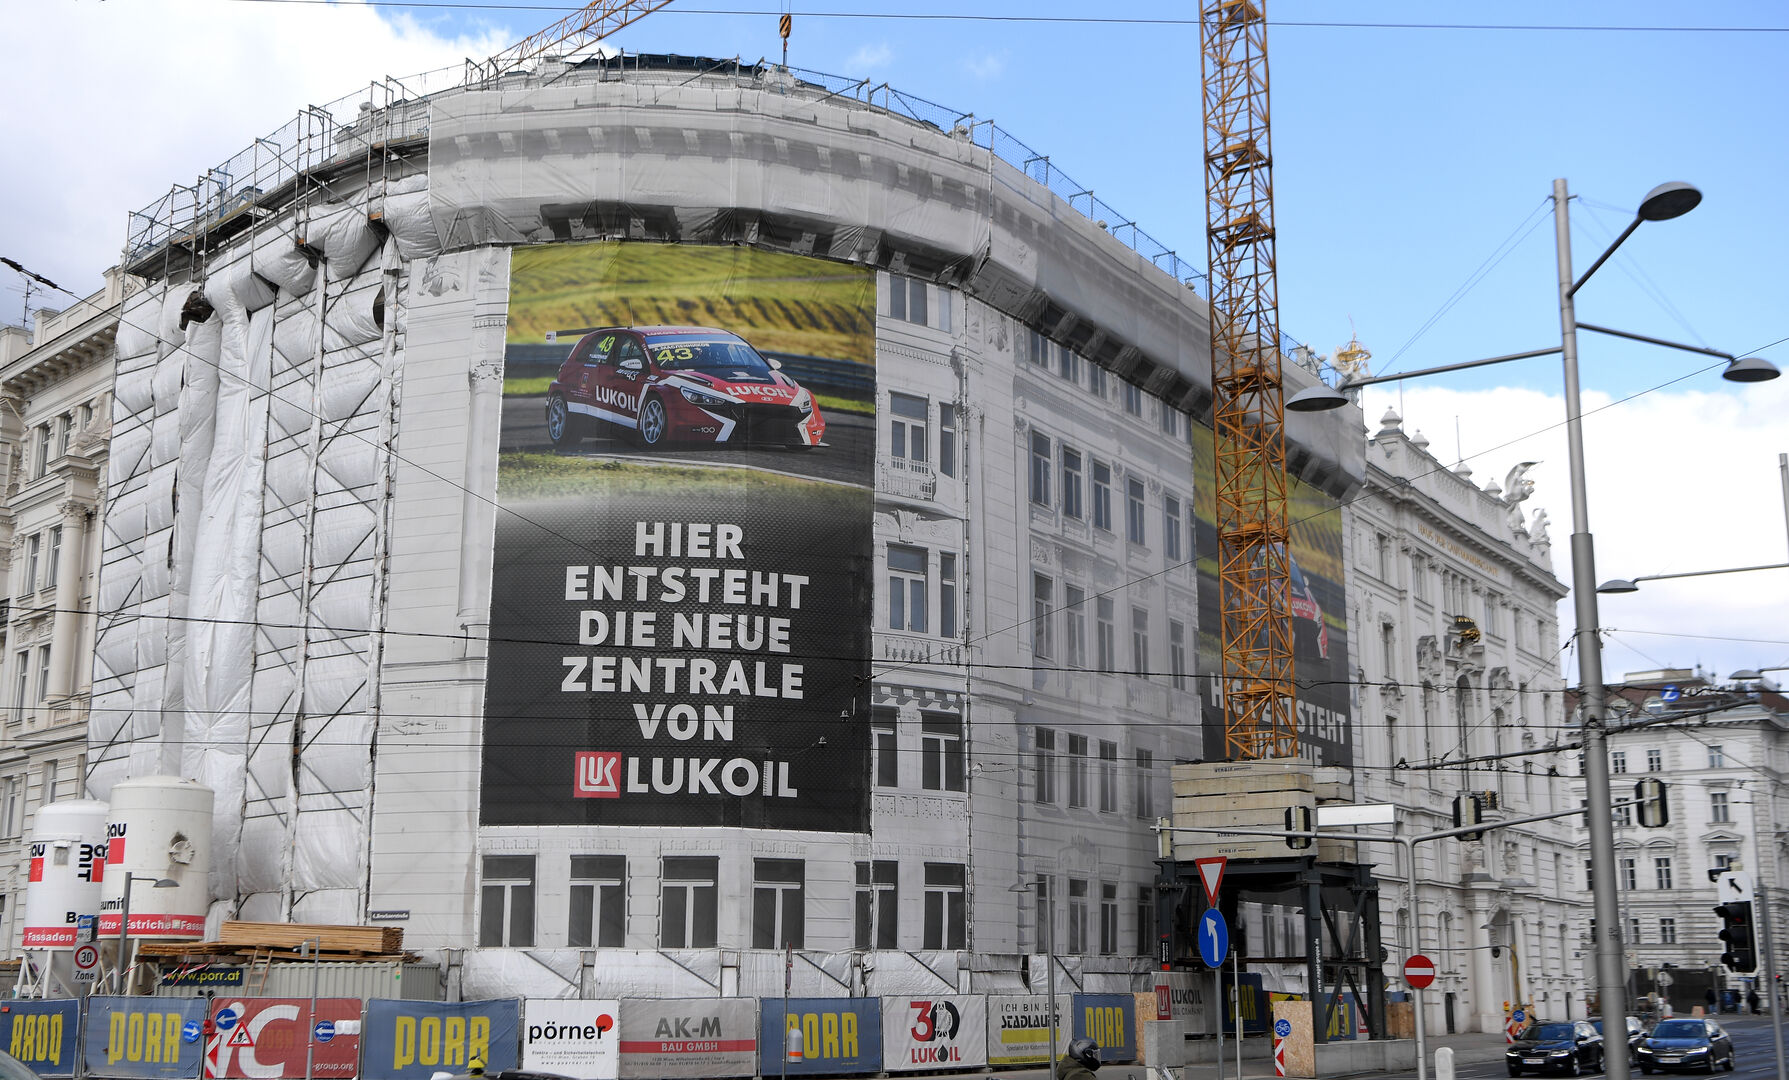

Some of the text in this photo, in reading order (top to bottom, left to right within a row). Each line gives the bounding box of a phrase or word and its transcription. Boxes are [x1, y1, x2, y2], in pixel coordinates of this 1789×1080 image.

[598, 336, 616, 352] 43
[657, 348, 693, 361] 43
[595, 385, 638, 413] LUKOIL
[726, 385, 794, 399] LUKOIL
[635, 521, 745, 560] HIER
[565, 565, 810, 609] ENTSTEHT
[578, 610, 791, 653] DIE NEUE
[561, 656, 804, 700] ZENTRALE
[633, 703, 735, 741] VON
[627, 756, 798, 799] LUKOIL
[27, 931, 73, 942] Fassaden
[81, 951, 93, 963] 30
[75, 970, 95, 980] Zone
[167, 970, 241, 984] www.porr.at
[1001, 1002, 1060, 1012] ICH BIN EN
[1171, 989, 1202, 1005] LUKOIL
[655, 1016, 722, 1038] AK-M
[910, 1000, 960, 1042] 30
[107, 1012, 182, 1066] PORR
[393, 1015, 490, 1070] PORR
[529, 1021, 606, 1044] pörner
[661, 1041, 719, 1052] BAU GMBH
